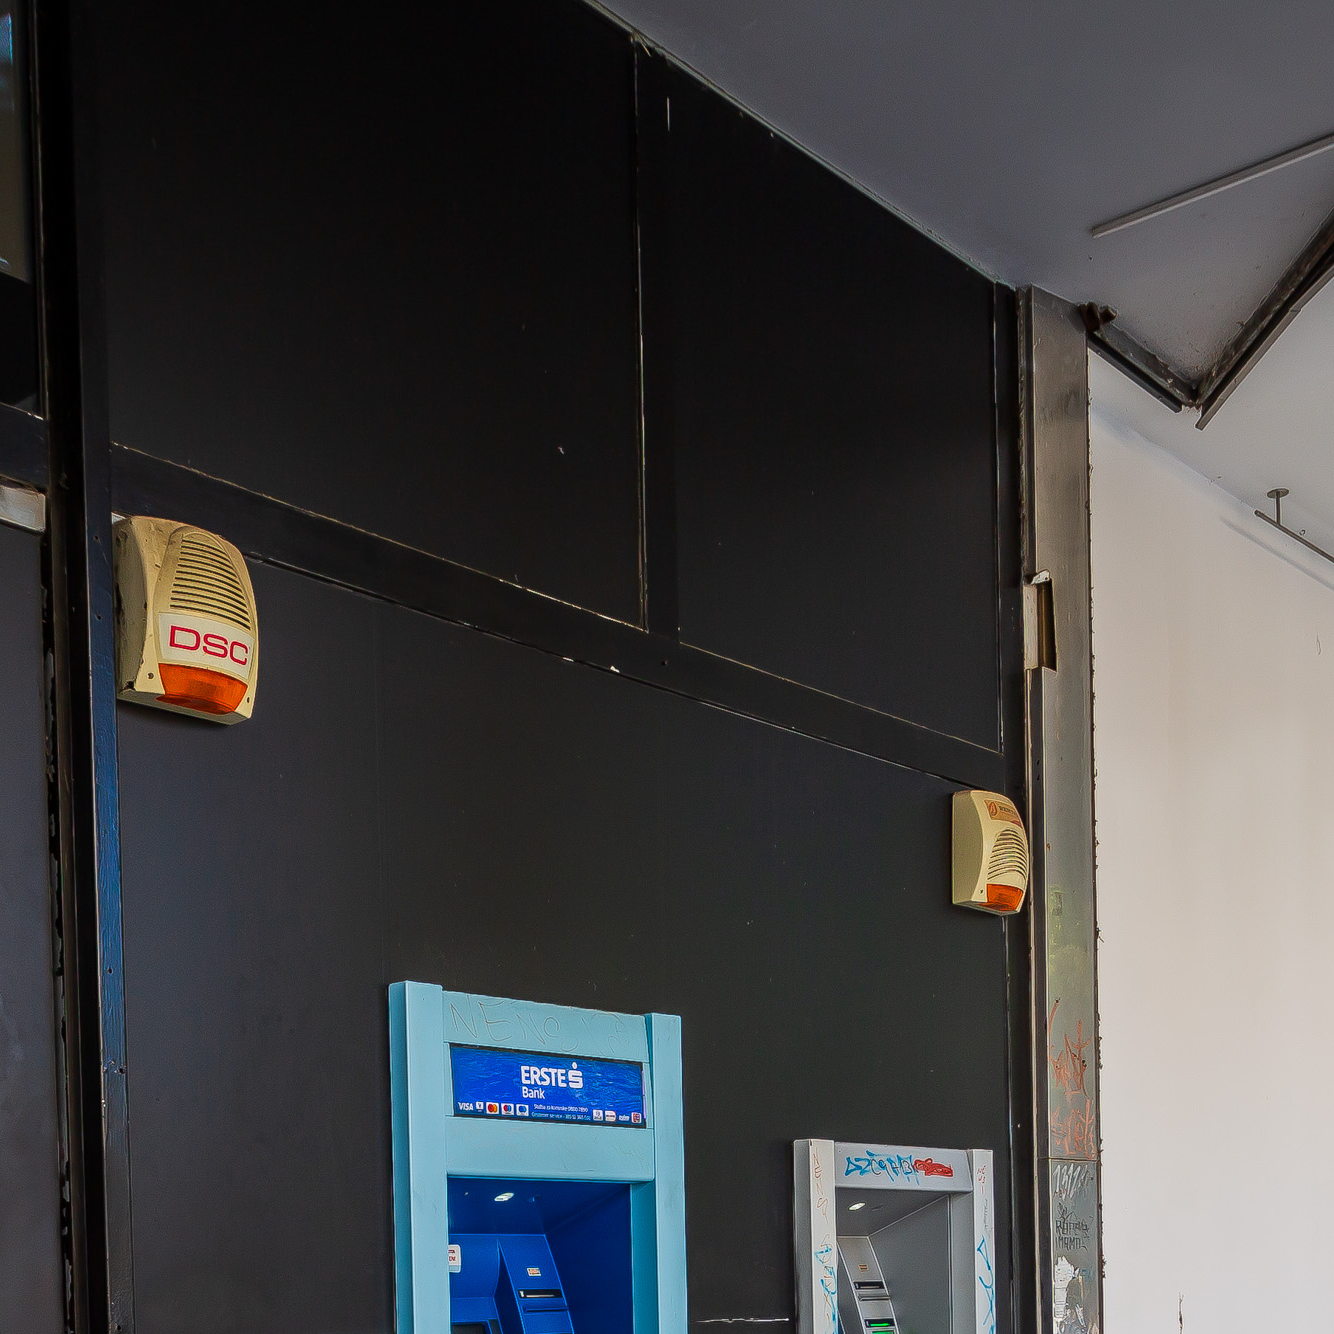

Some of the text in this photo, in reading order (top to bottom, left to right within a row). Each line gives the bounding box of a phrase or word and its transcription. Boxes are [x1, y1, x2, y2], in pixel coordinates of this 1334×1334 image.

[169, 625, 249, 666] DSC
[520, 1066, 567, 1088] ERSTE
[522, 1086, 546, 1100] Bank
[458, 1101, 474, 1112] VISA
